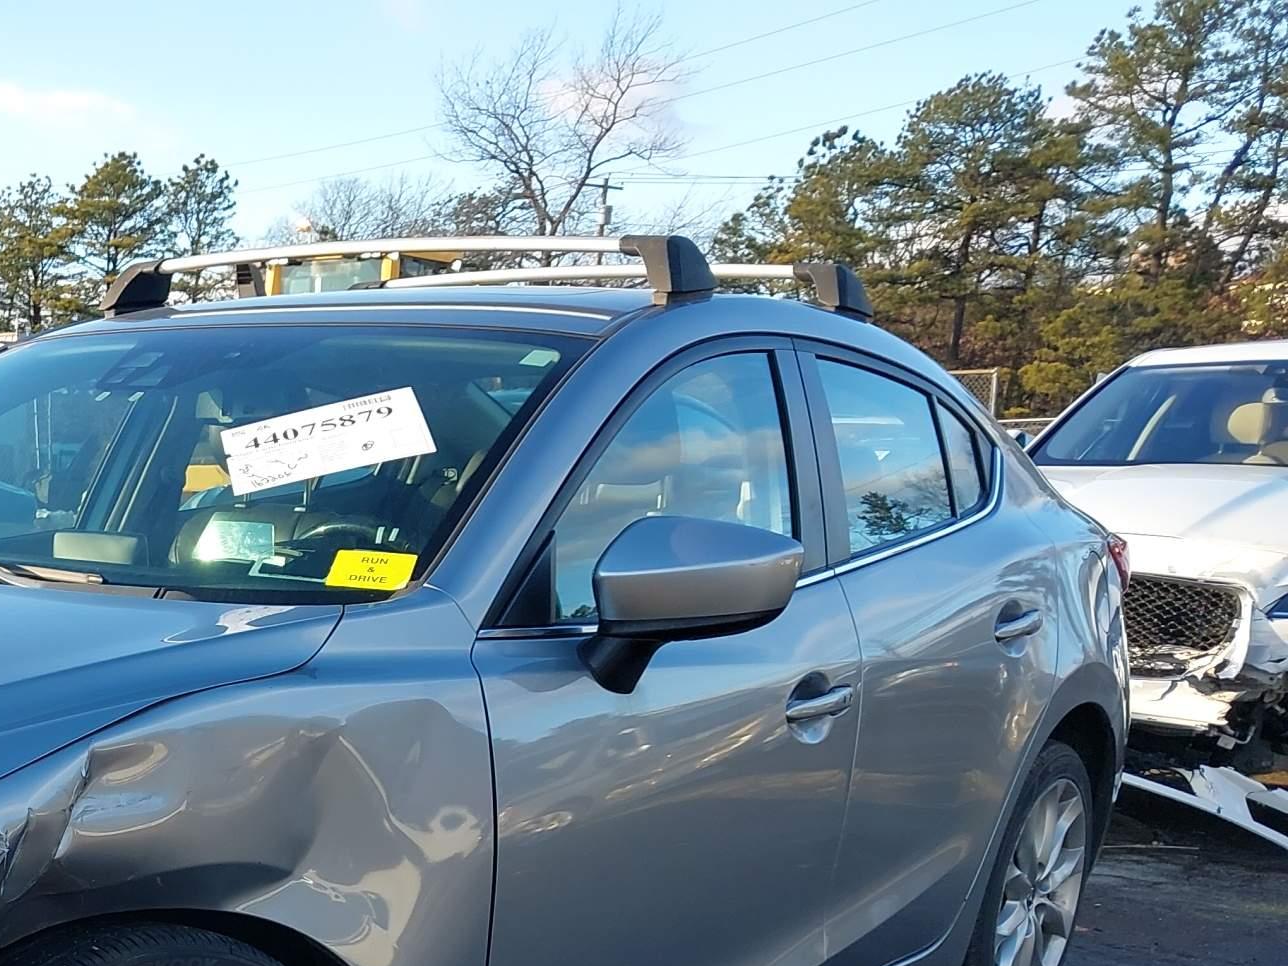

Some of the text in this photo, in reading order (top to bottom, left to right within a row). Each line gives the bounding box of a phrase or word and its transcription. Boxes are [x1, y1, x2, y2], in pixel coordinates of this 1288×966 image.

[245, 406, 393, 449] 44075879
[361, 556, 389, 565] RUN
[349, 574, 388, 584] DRIVE
